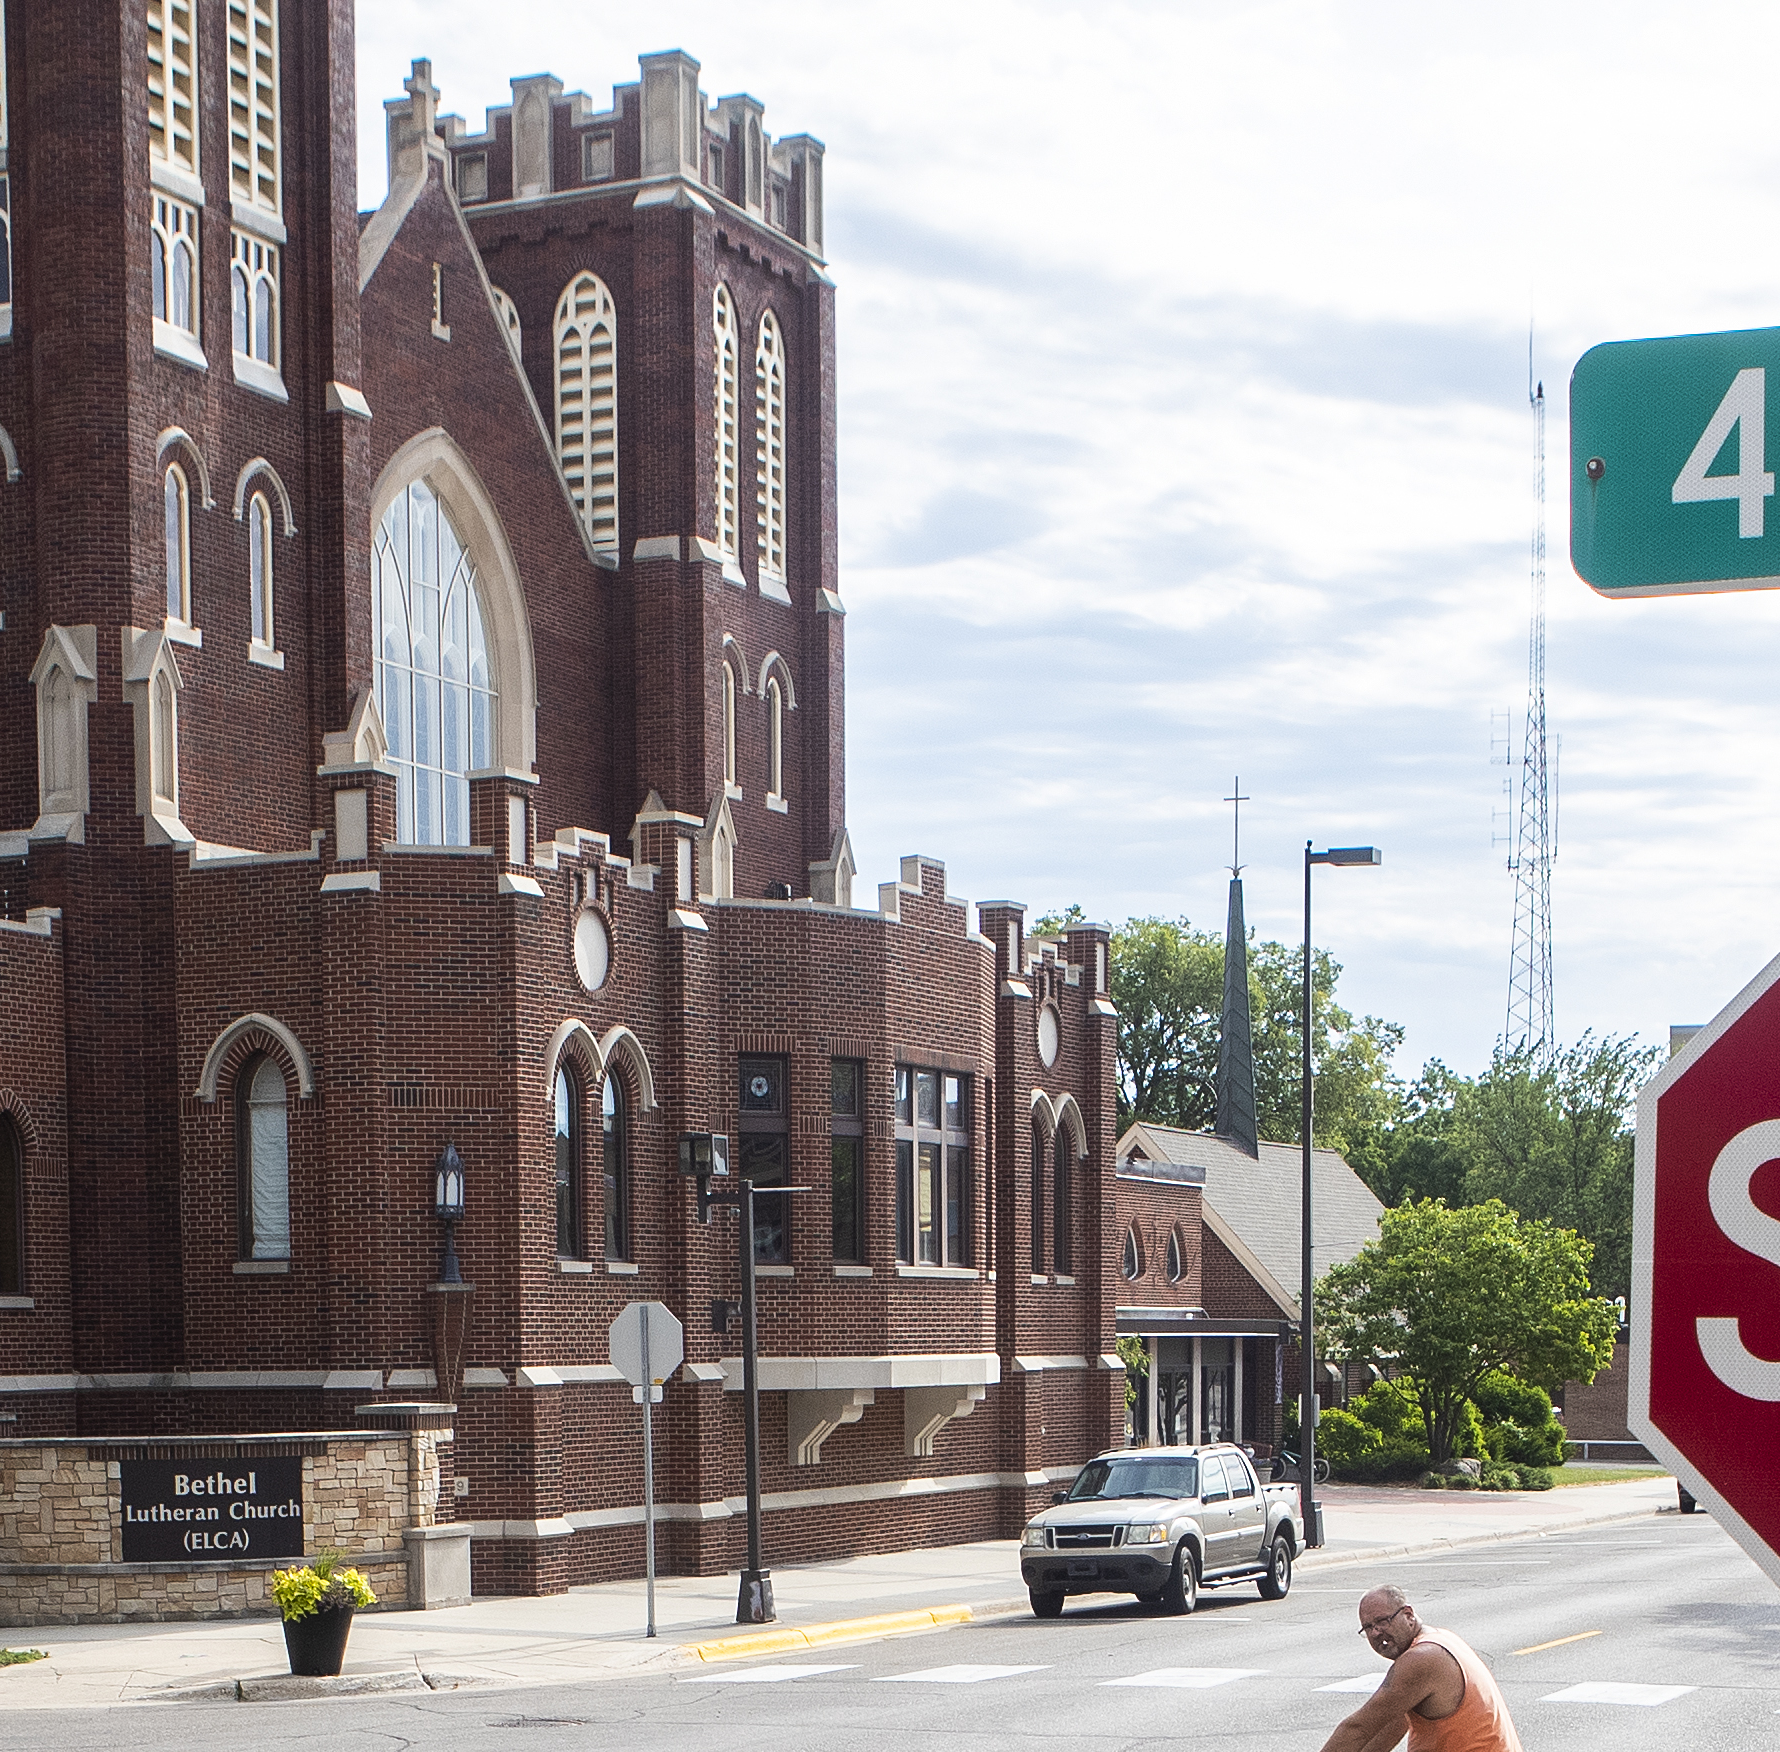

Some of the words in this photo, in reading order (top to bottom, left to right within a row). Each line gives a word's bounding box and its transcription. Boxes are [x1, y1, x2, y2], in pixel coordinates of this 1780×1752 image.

[175, 1472, 257, 1496] Bethel
[126, 1504, 219, 1522] Lutheran
[229, 1499, 301, 1520] Church
[184, 1528, 250, 1552] (ELCA)
